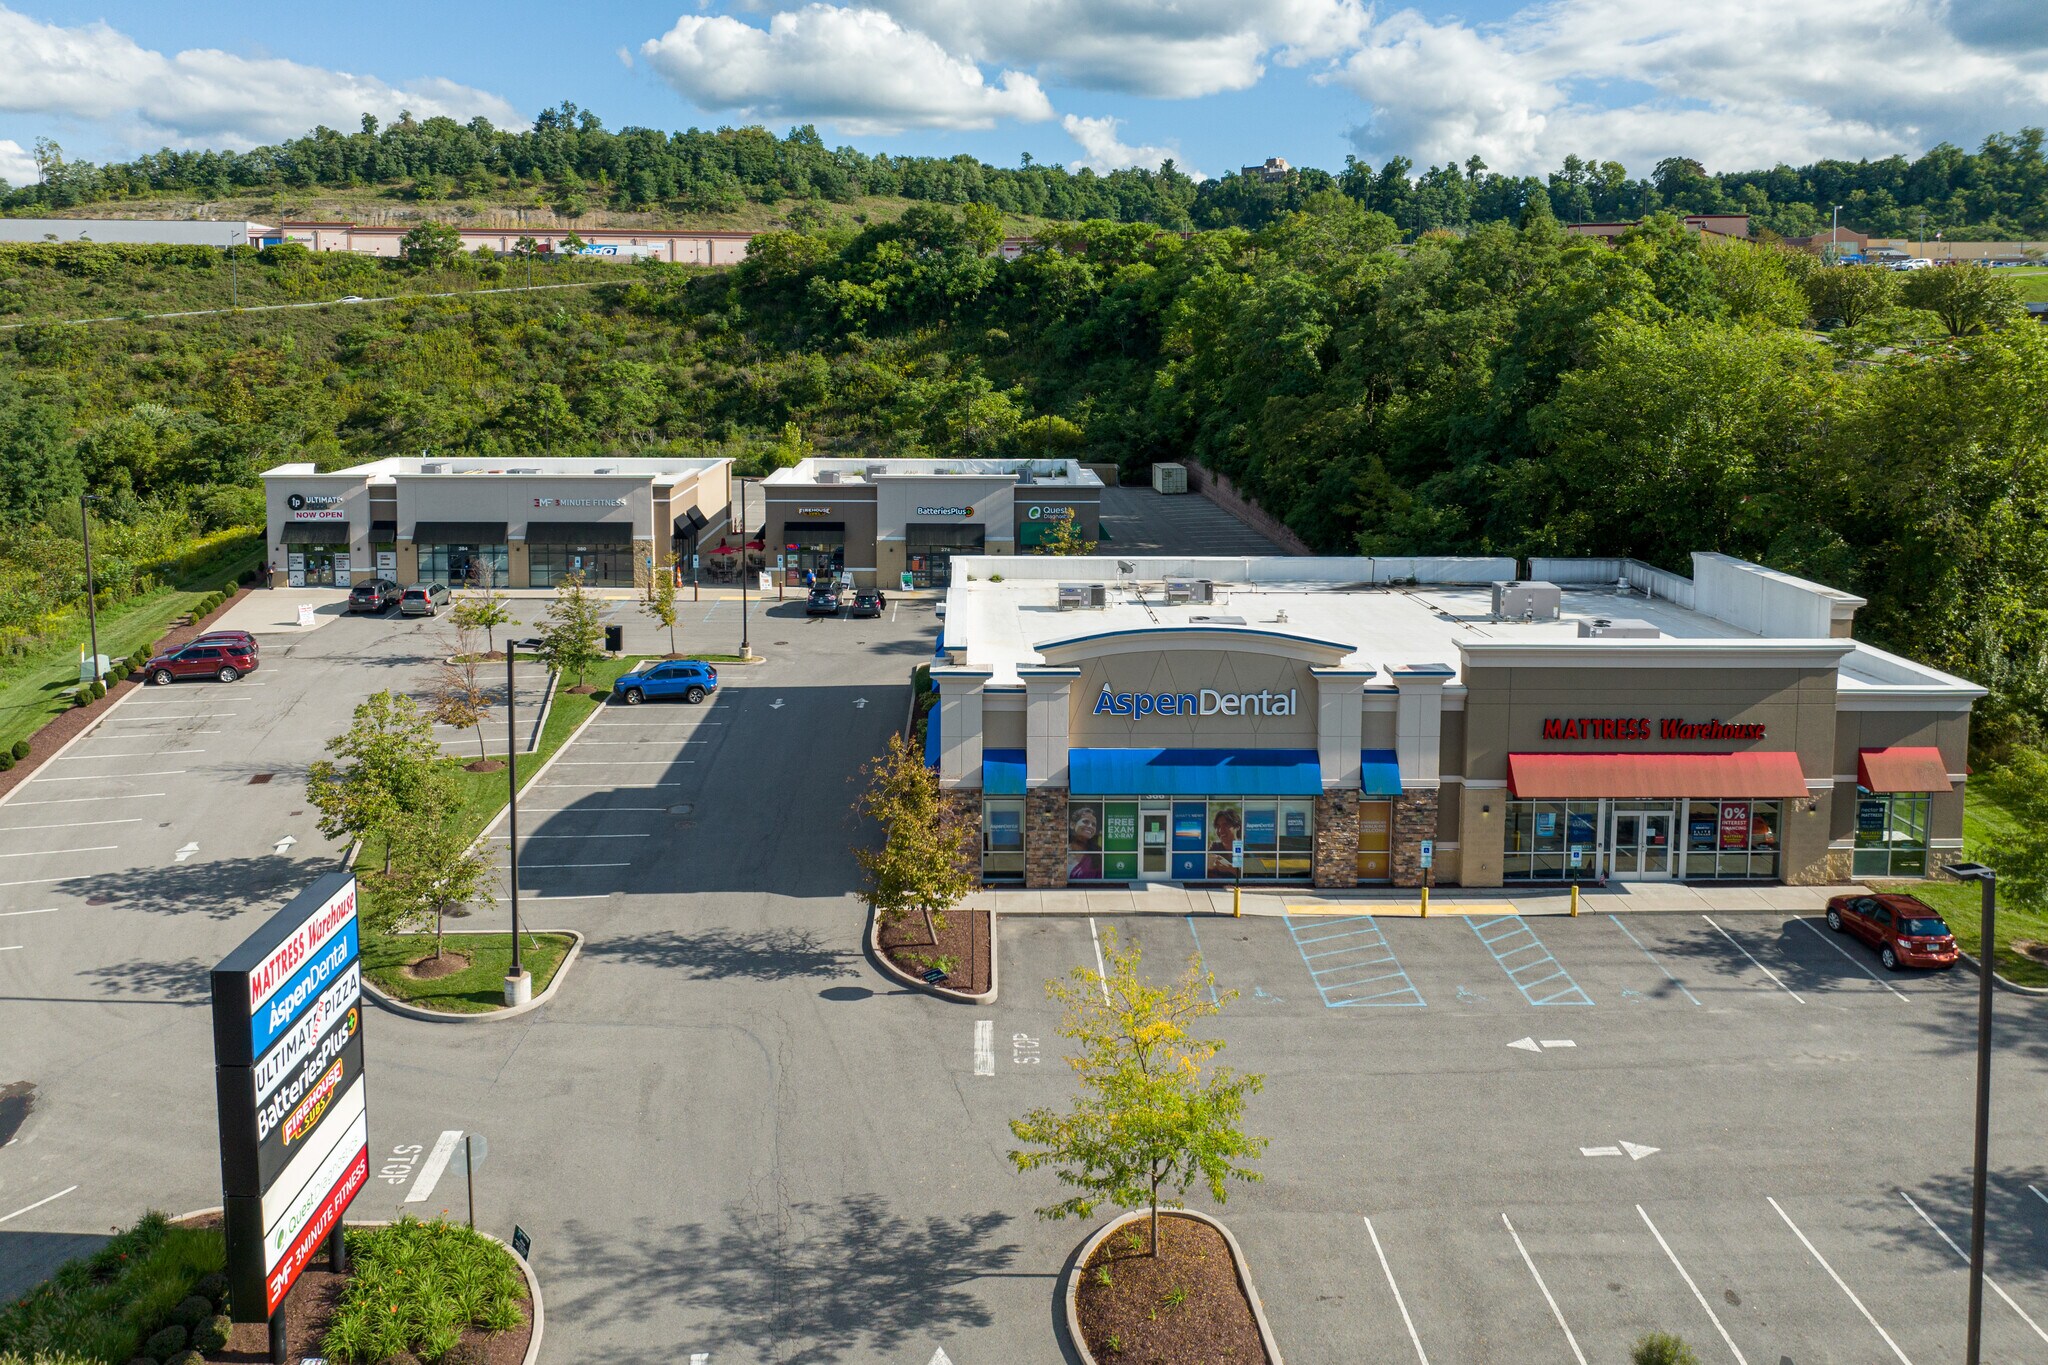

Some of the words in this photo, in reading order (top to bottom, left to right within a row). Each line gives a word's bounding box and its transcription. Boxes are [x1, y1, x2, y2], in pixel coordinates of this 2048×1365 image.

[593, 498, 627, 507] FITNESS
[1093, 682, 1297, 721] AspenDental
[1543, 718, 1651, 740] MATTRESS
[1660, 719, 1767, 740] Warehouse
[1107, 818, 1135, 826] FREE
[1107, 826, 1135, 834] EXAM
[1724, 807, 1746, 820] 0%
[251, 932, 305, 1005] MATTRESS
[308, 892, 355, 950] Warehouse
[269, 936, 348, 1035] AspenDental
[325, 973, 358, 1020] PIZZA
[311, 1000, 325, 1046] OPEN
[1012, 1032, 1040, 1064] STOP
[284, 1062, 342, 1146] FIREHOUSE
[304, 1096, 326, 1128] SUBS
[378, 1144, 423, 1185] STOP
[288, 1193, 314, 1234] Quest
[295, 1203, 334, 1265] 3MINUTE
[334, 1158, 366, 1212] FITNESS
